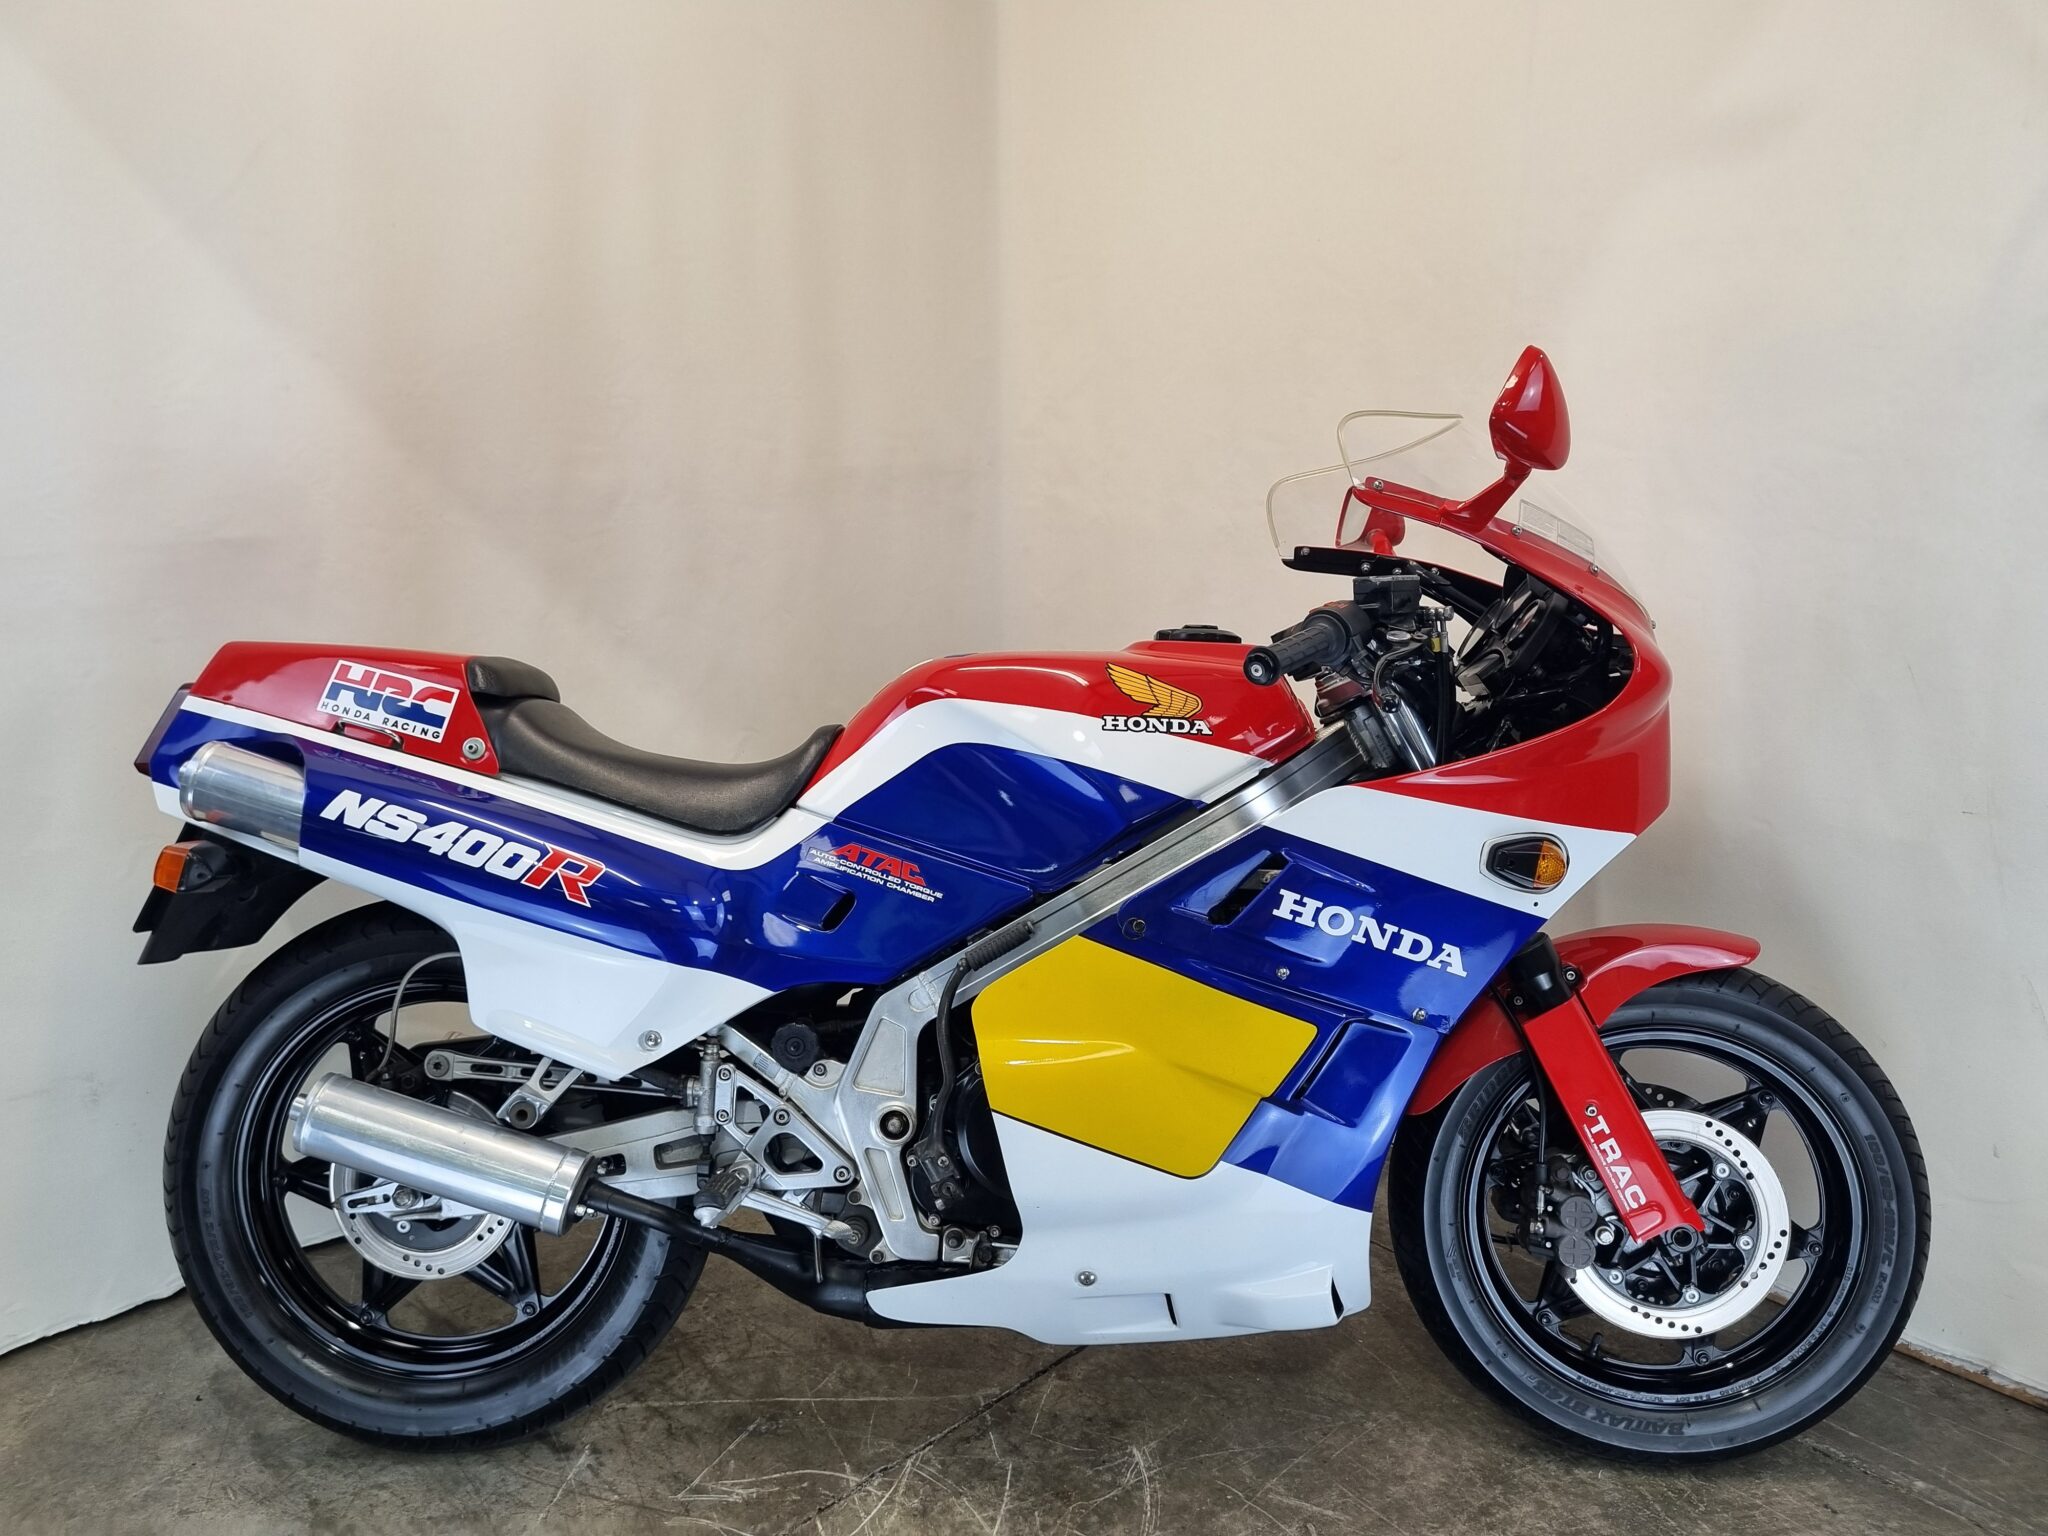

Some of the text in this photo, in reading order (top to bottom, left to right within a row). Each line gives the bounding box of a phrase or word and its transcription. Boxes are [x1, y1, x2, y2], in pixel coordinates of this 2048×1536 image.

[321, 701, 441, 739] HONDA RACING
[325, 664, 455, 729] HRC
[1102, 715, 1213, 737] HONDA
[320, 789, 605, 908] NS400R
[833, 842, 927, 887] ATAC
[809, 849, 944, 899] AUTO-CONTROLLED TORQUE
[813, 857, 935, 903] AMPLIFICATION CHAMBER
[1273, 888, 1468, 978] HONDA
[1590, 1114, 1647, 1209] TRAC
